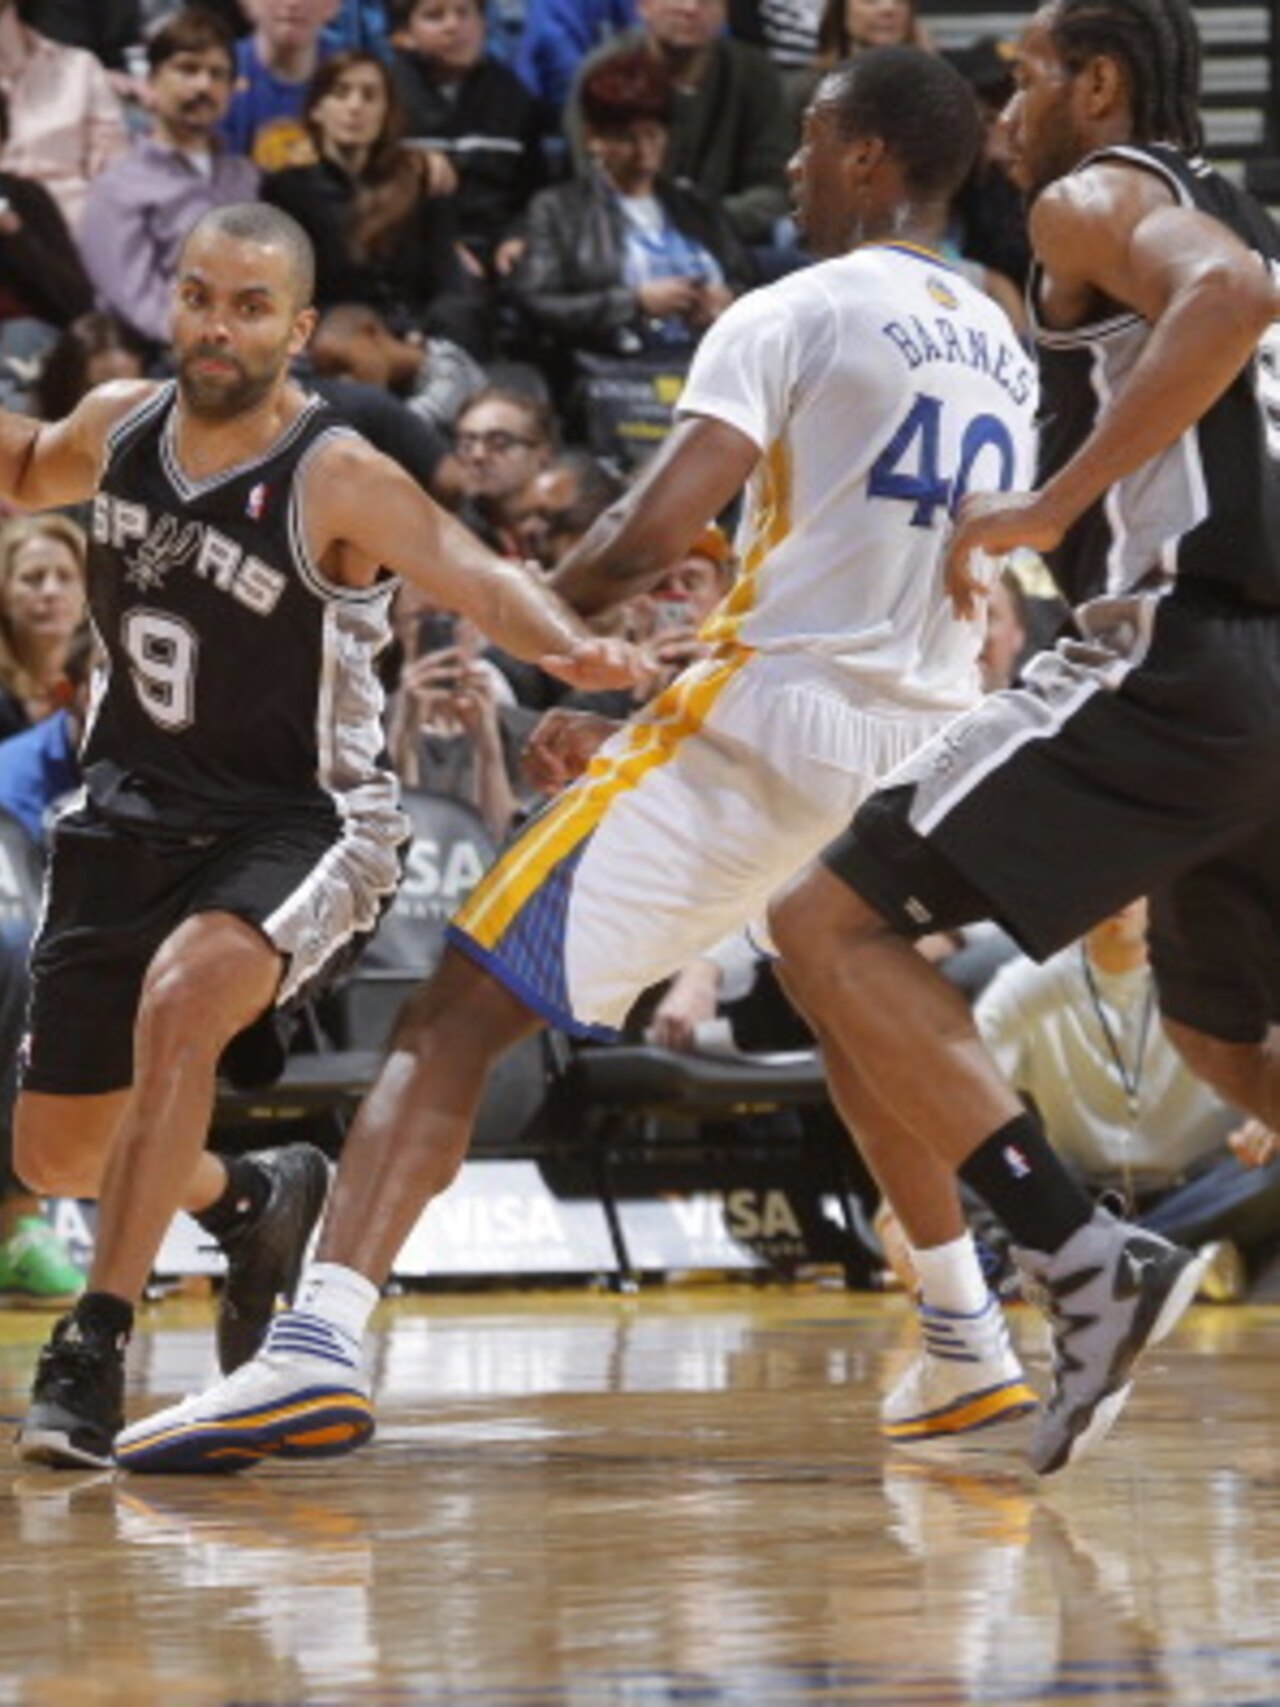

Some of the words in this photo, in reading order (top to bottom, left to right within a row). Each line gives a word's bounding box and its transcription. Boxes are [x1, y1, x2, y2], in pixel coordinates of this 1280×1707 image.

[882, 314, 1030, 406] BARNES
[866, 391, 1016, 527] 40
[93, 493, 287, 616] SPURS
[120, 604, 200, 735] 9
[401, 839, 484, 898] SA
[664, 1189, 802, 1240] VISA
